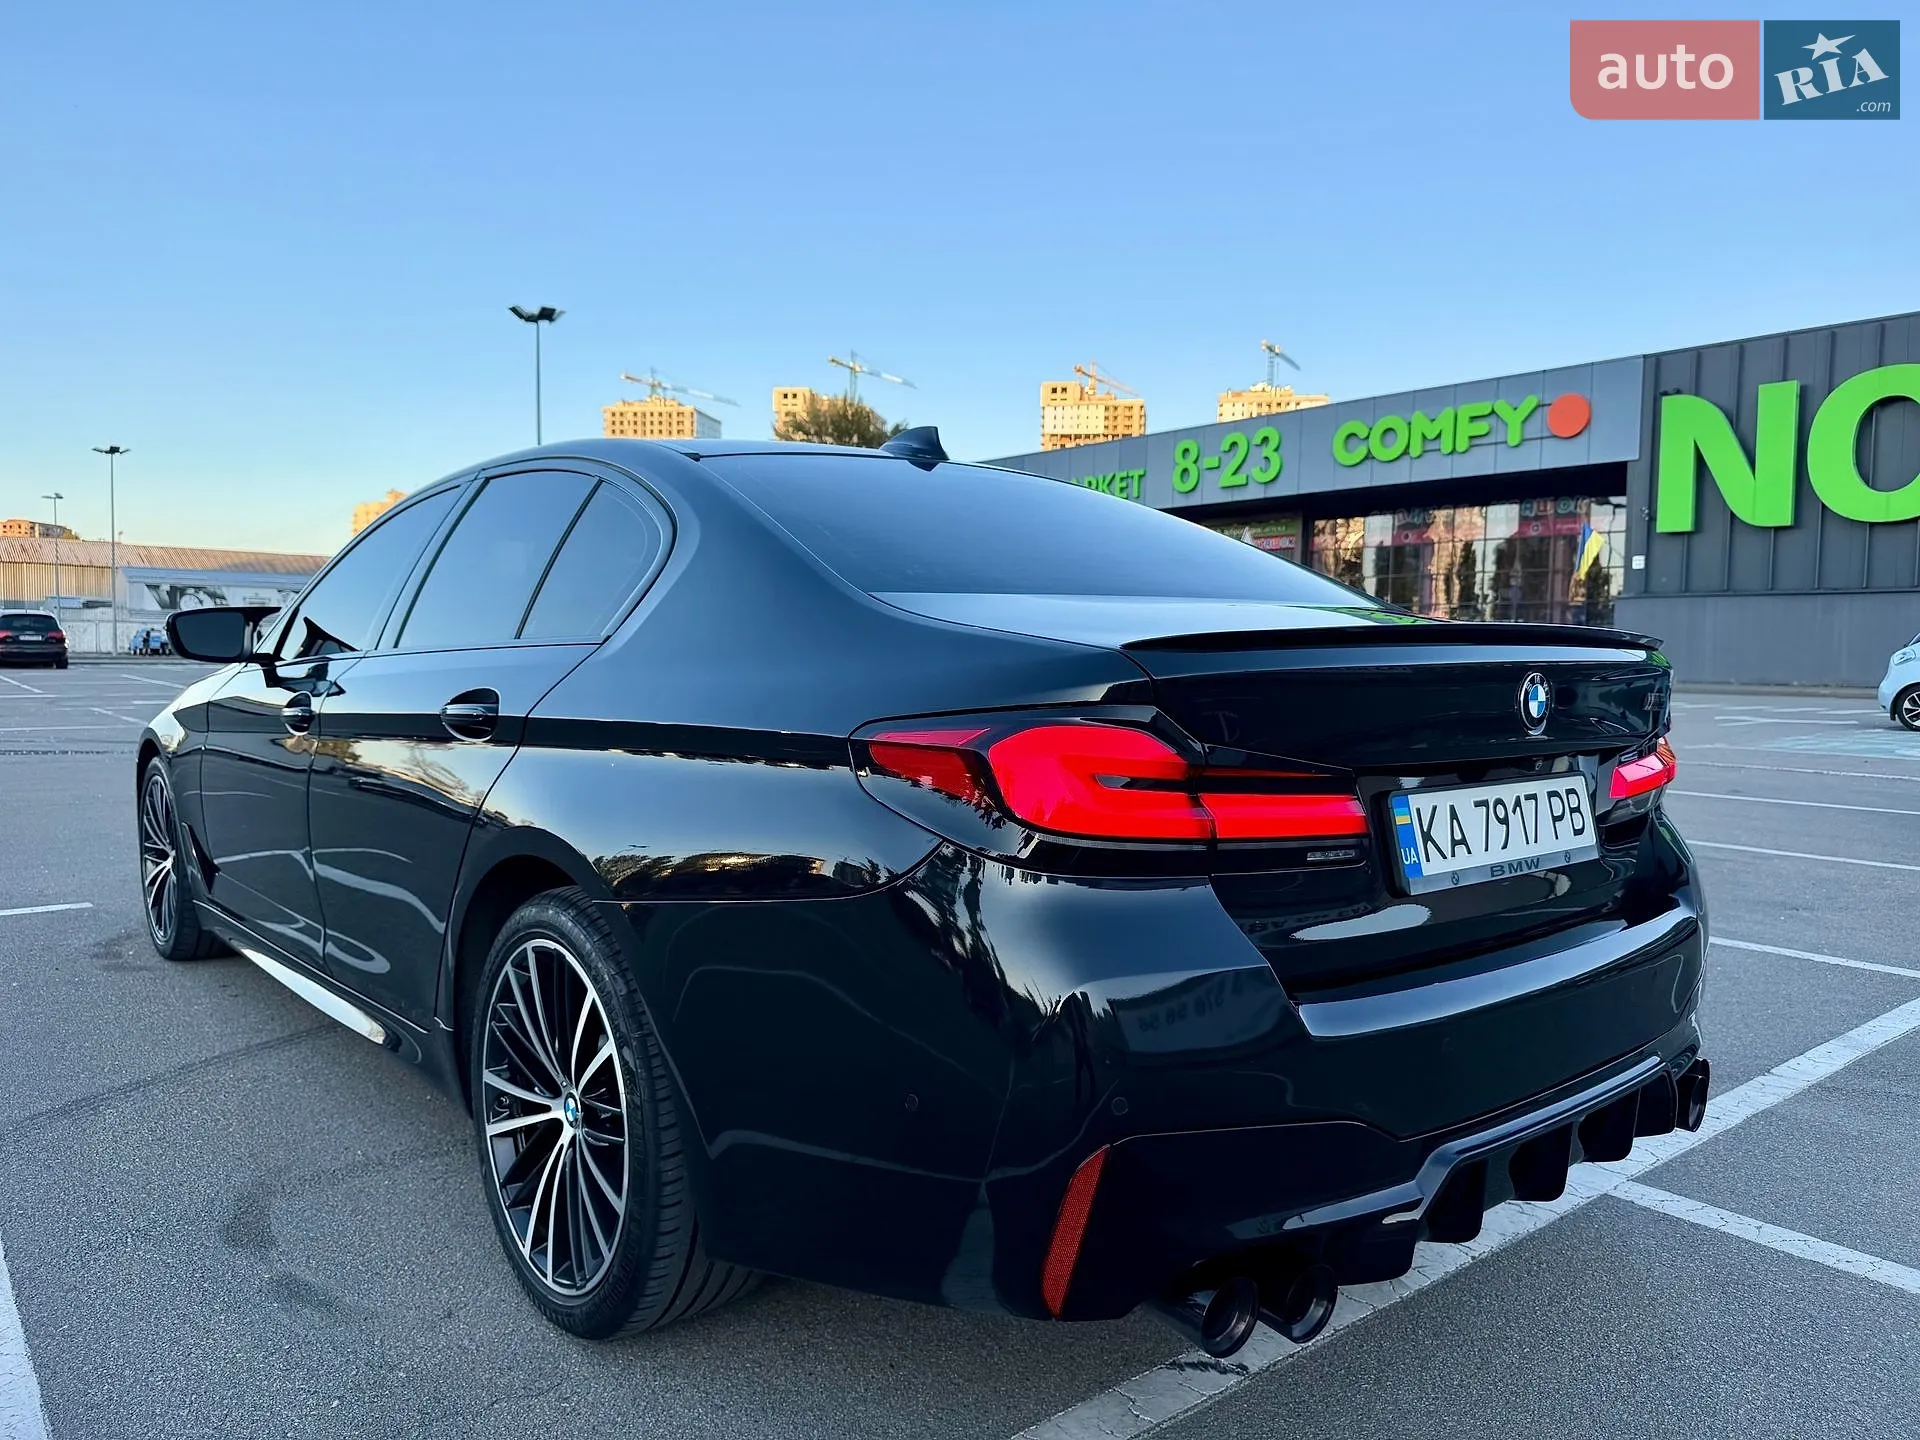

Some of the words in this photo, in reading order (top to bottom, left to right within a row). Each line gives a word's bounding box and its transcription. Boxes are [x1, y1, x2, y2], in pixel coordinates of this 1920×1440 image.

[1172, 426, 1284, 494] 8-23
[1332, 394, 1540, 467] COMFY
[1401, 847, 1420, 865] UA
[1415, 804, 1472, 863] KA
[1472, 792, 1538, 853] 7917
[1546, 787, 1585, 840] PB
[1489, 857, 1541, 878] BMW
